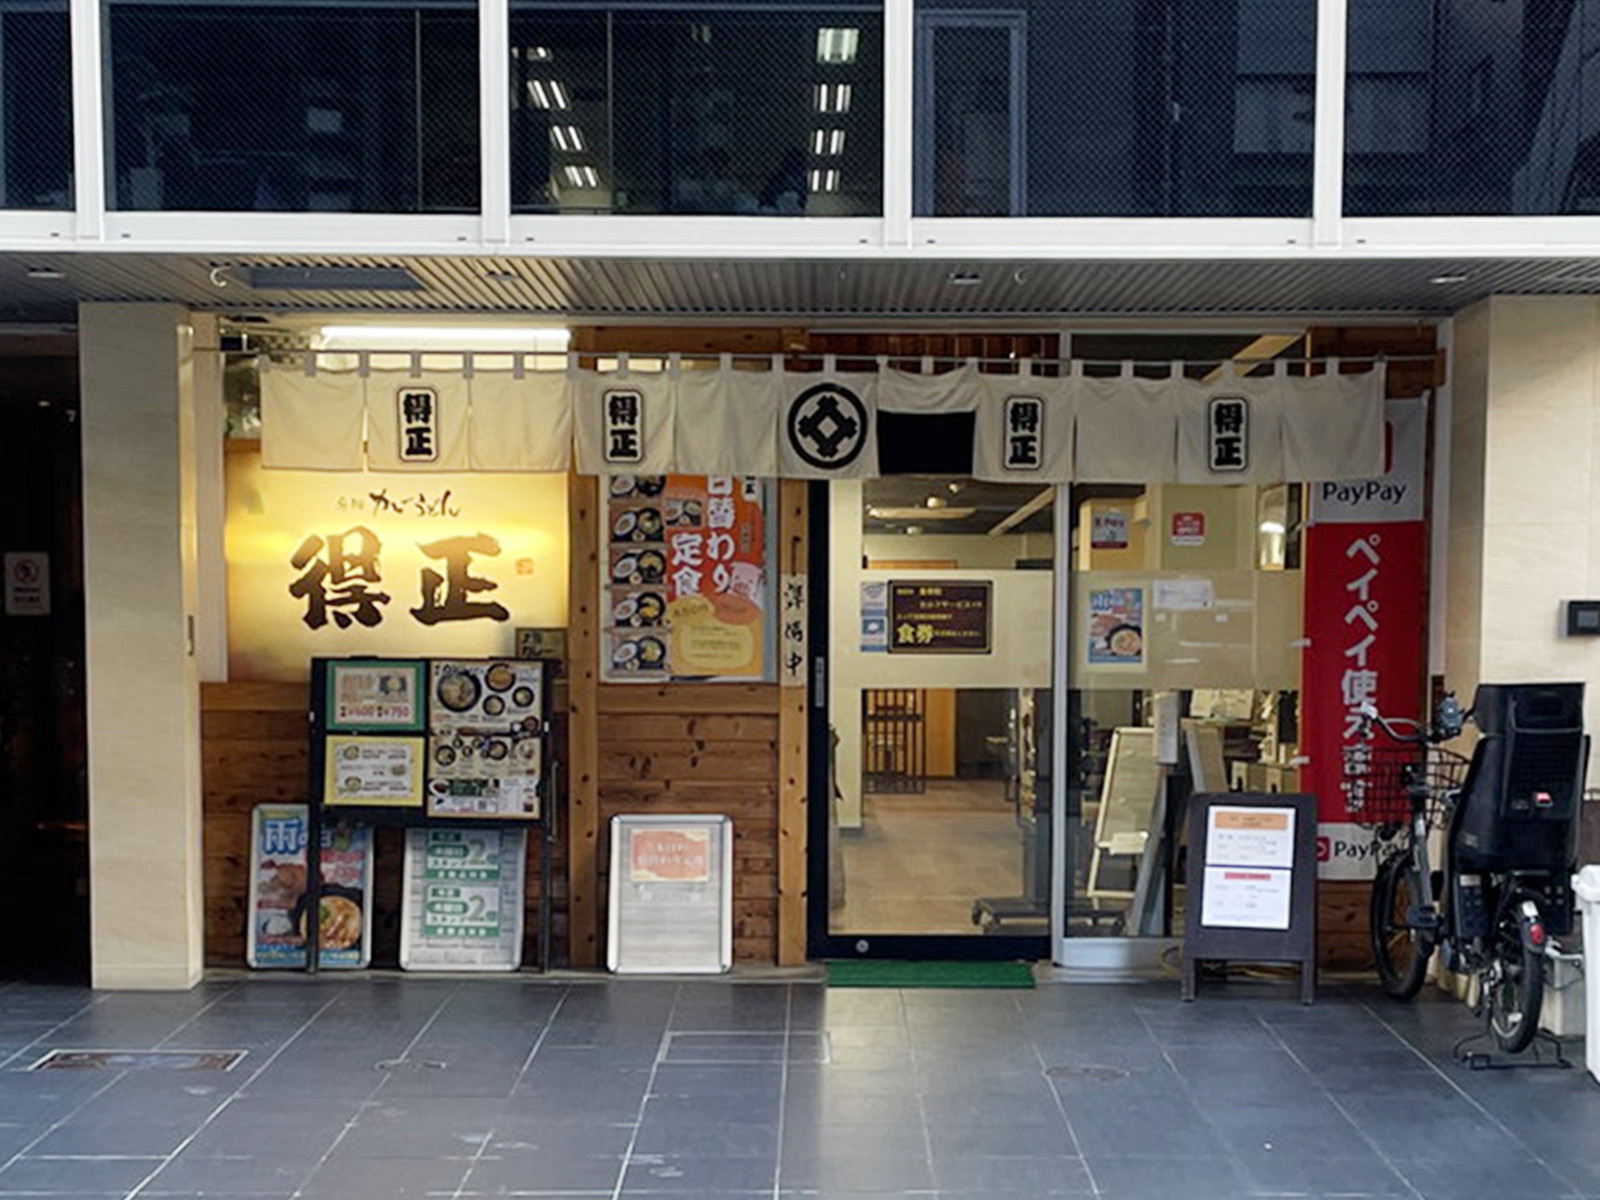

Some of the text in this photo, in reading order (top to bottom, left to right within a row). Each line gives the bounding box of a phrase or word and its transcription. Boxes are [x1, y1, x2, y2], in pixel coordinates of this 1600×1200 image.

[403, 393, 433, 456] 得正
[608, 395, 639, 458] 得正
[1009, 402, 1039, 465] 得正
[1213, 403, 1244, 467] 得正
[1322, 481, 1407, 506] PayPay
[288, 525, 510, 631] 得正
[671, 532, 703, 597] 定食
